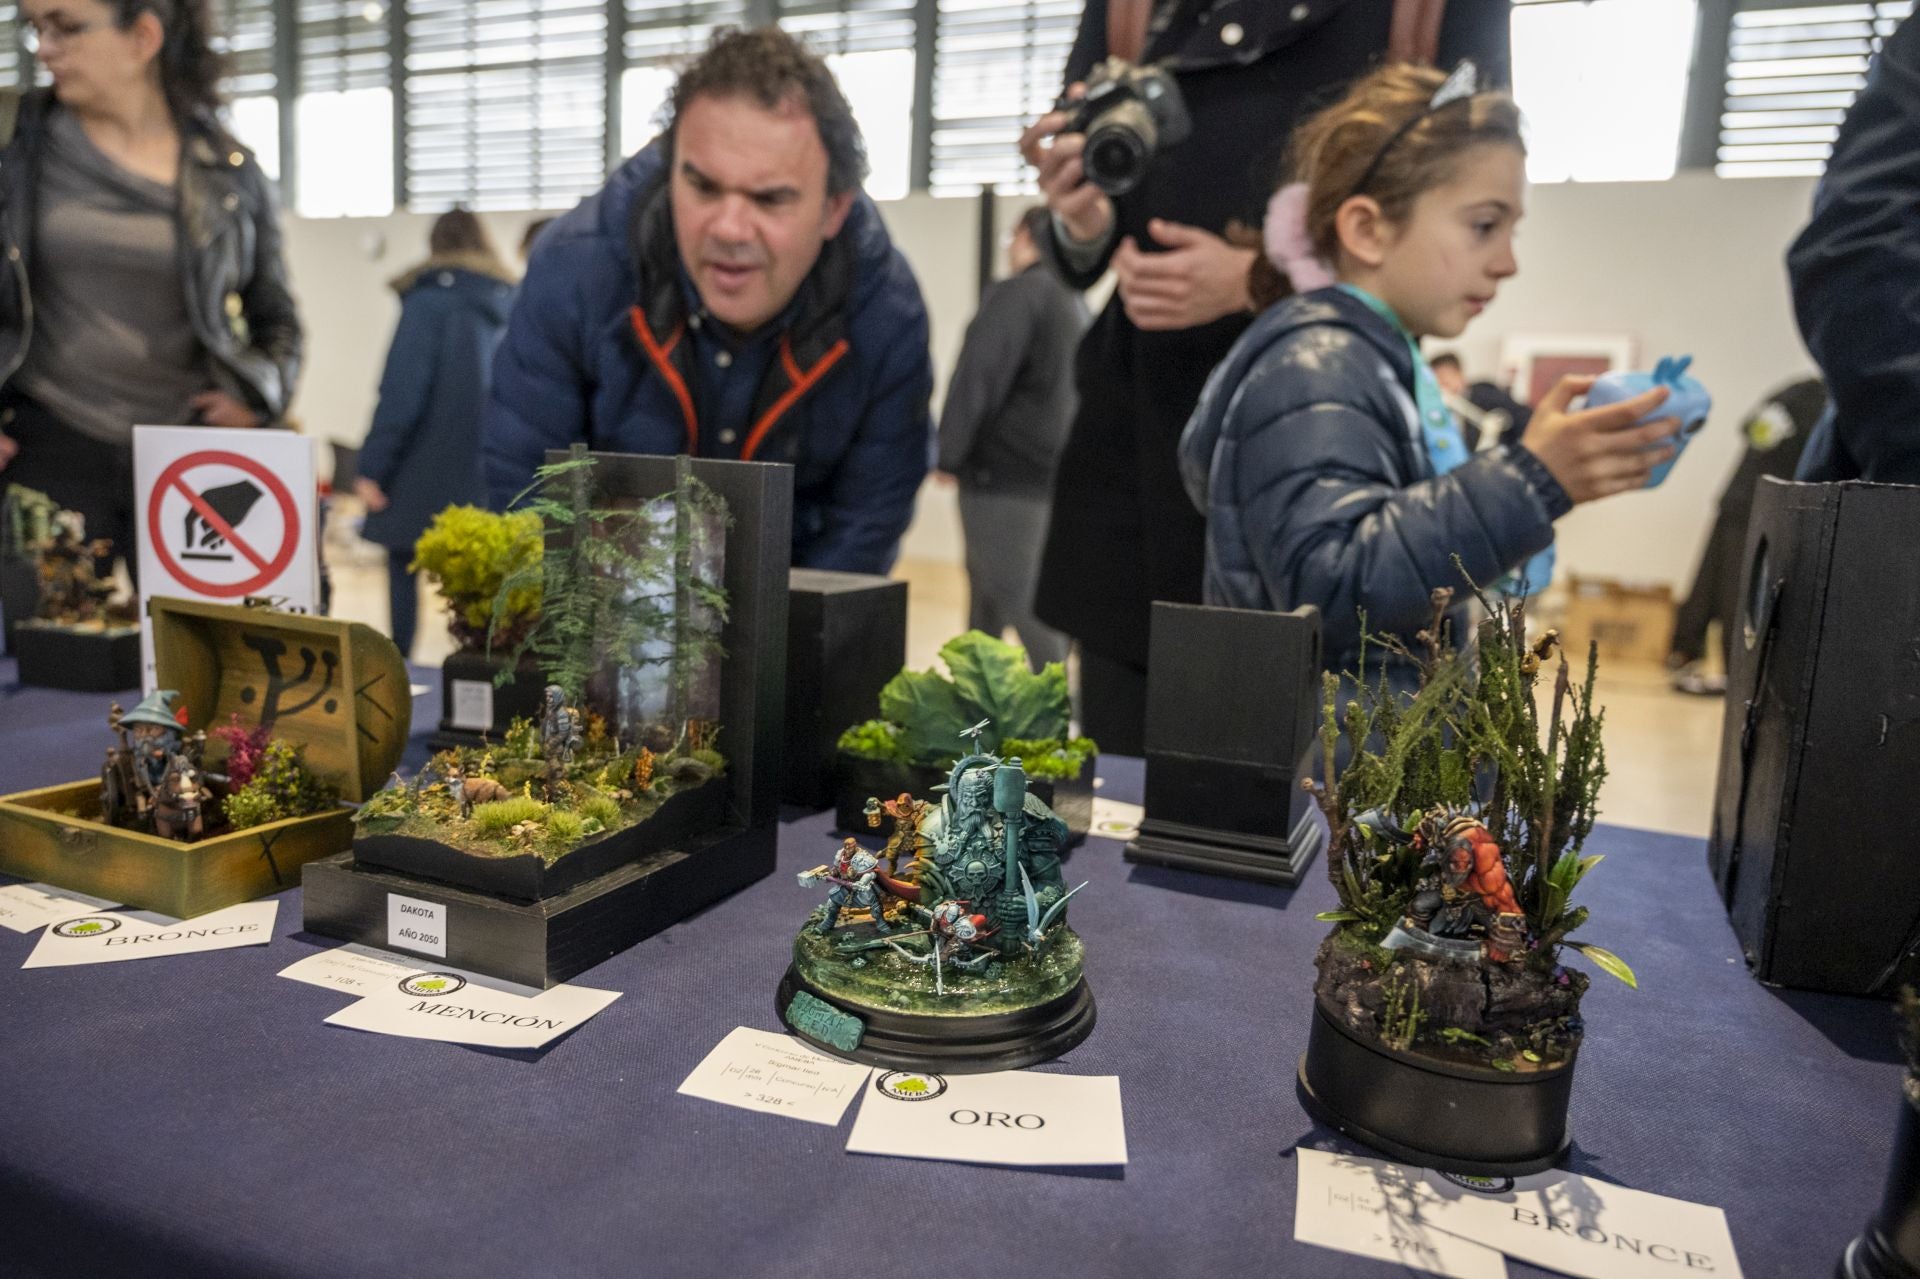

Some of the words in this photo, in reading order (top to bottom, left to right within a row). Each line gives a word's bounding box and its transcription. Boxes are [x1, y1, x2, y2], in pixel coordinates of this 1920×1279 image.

[401, 904, 434, 919] DAKOTA
[105, 922, 259, 947] BRONCE
[398, 927, 418, 940] AÑO
[419, 932, 439, 945] 2050
[409, 1000, 564, 1030] MENCIÓN
[755, 1093, 783, 1105] 328
[949, 1109, 1046, 1130] ORO
[1511, 1206, 1716, 1272] BRONCE
